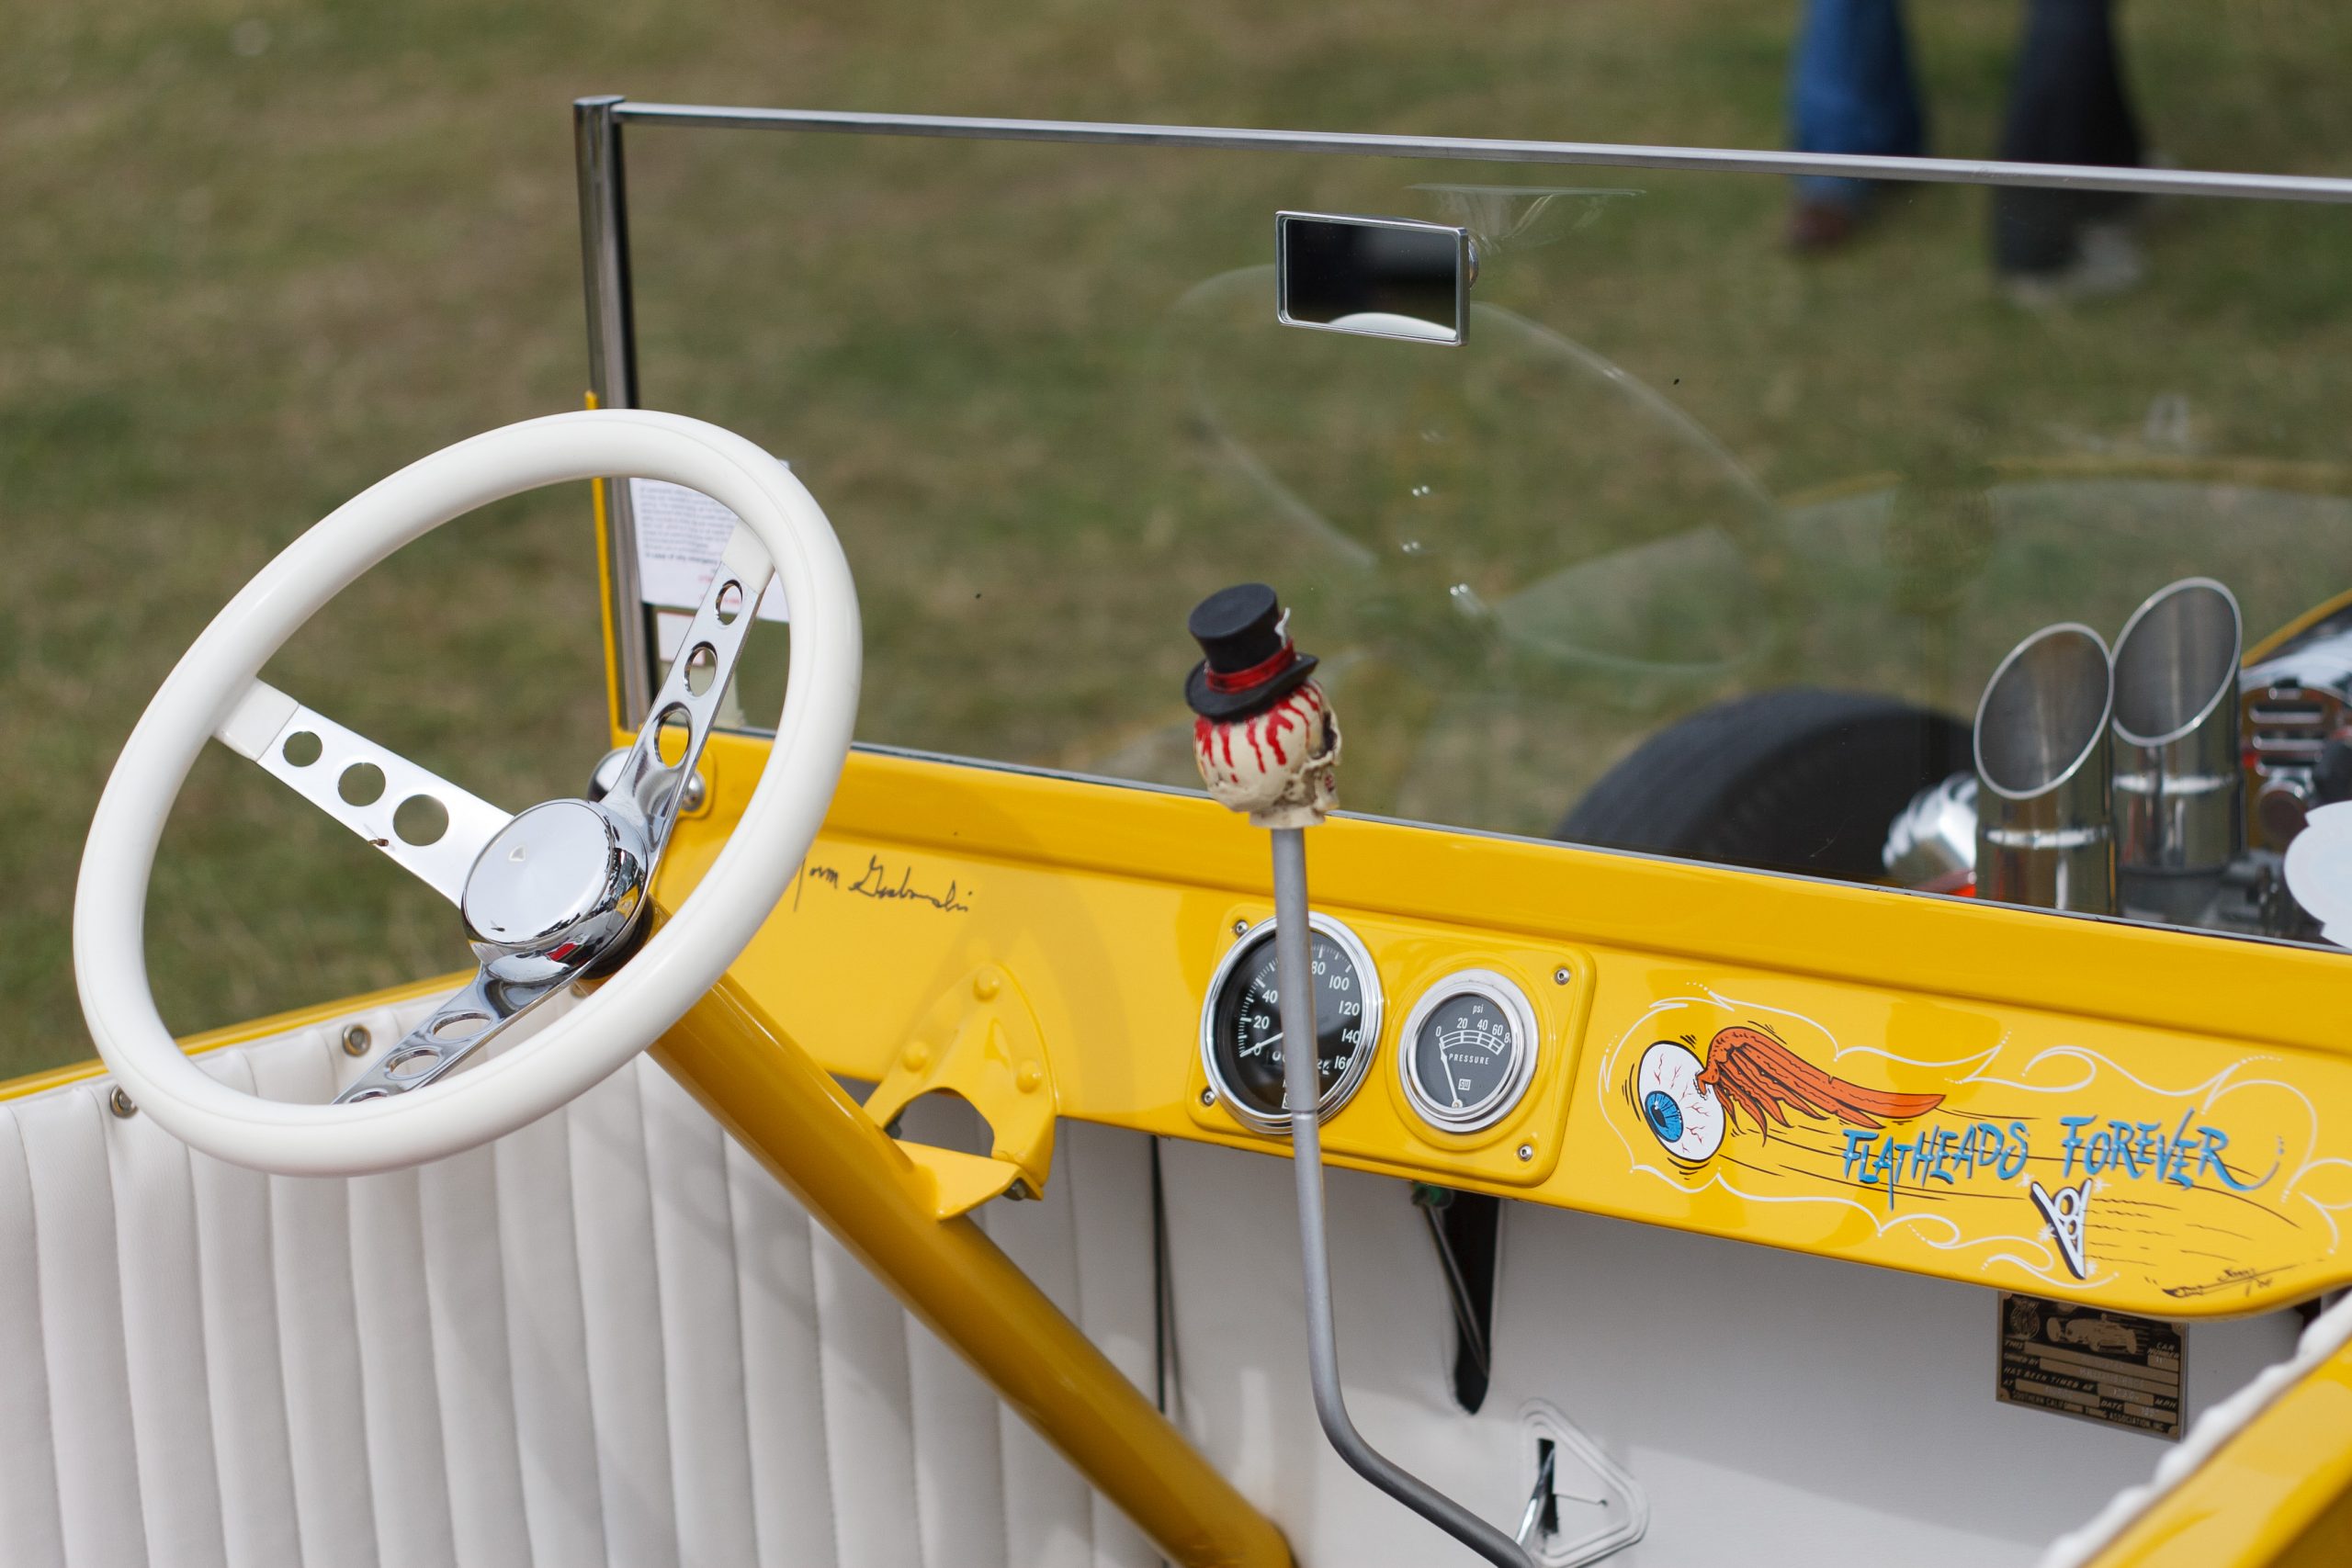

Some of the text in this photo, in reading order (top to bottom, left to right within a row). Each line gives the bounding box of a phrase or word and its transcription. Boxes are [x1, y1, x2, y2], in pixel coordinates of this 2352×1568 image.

[1329, 975, 1350, 991] 100
[1262, 989, 1278, 1004] 40
[1339, 1000, 1360, 1016] 120
[1472, 1004, 1484, 1015] psi
[1253, 1015, 1270, 1030] 20
[1341, 1028, 1360, 1044] 140
[1435, 1017, 1511, 1044] 0 20 40 60 8
[1448, 1053, 1490, 1066] PRESSURE
[1459, 1079, 1470, 1089] SW
[1842, 1106, 2280, 1213] FLATHEADS FOREVER
